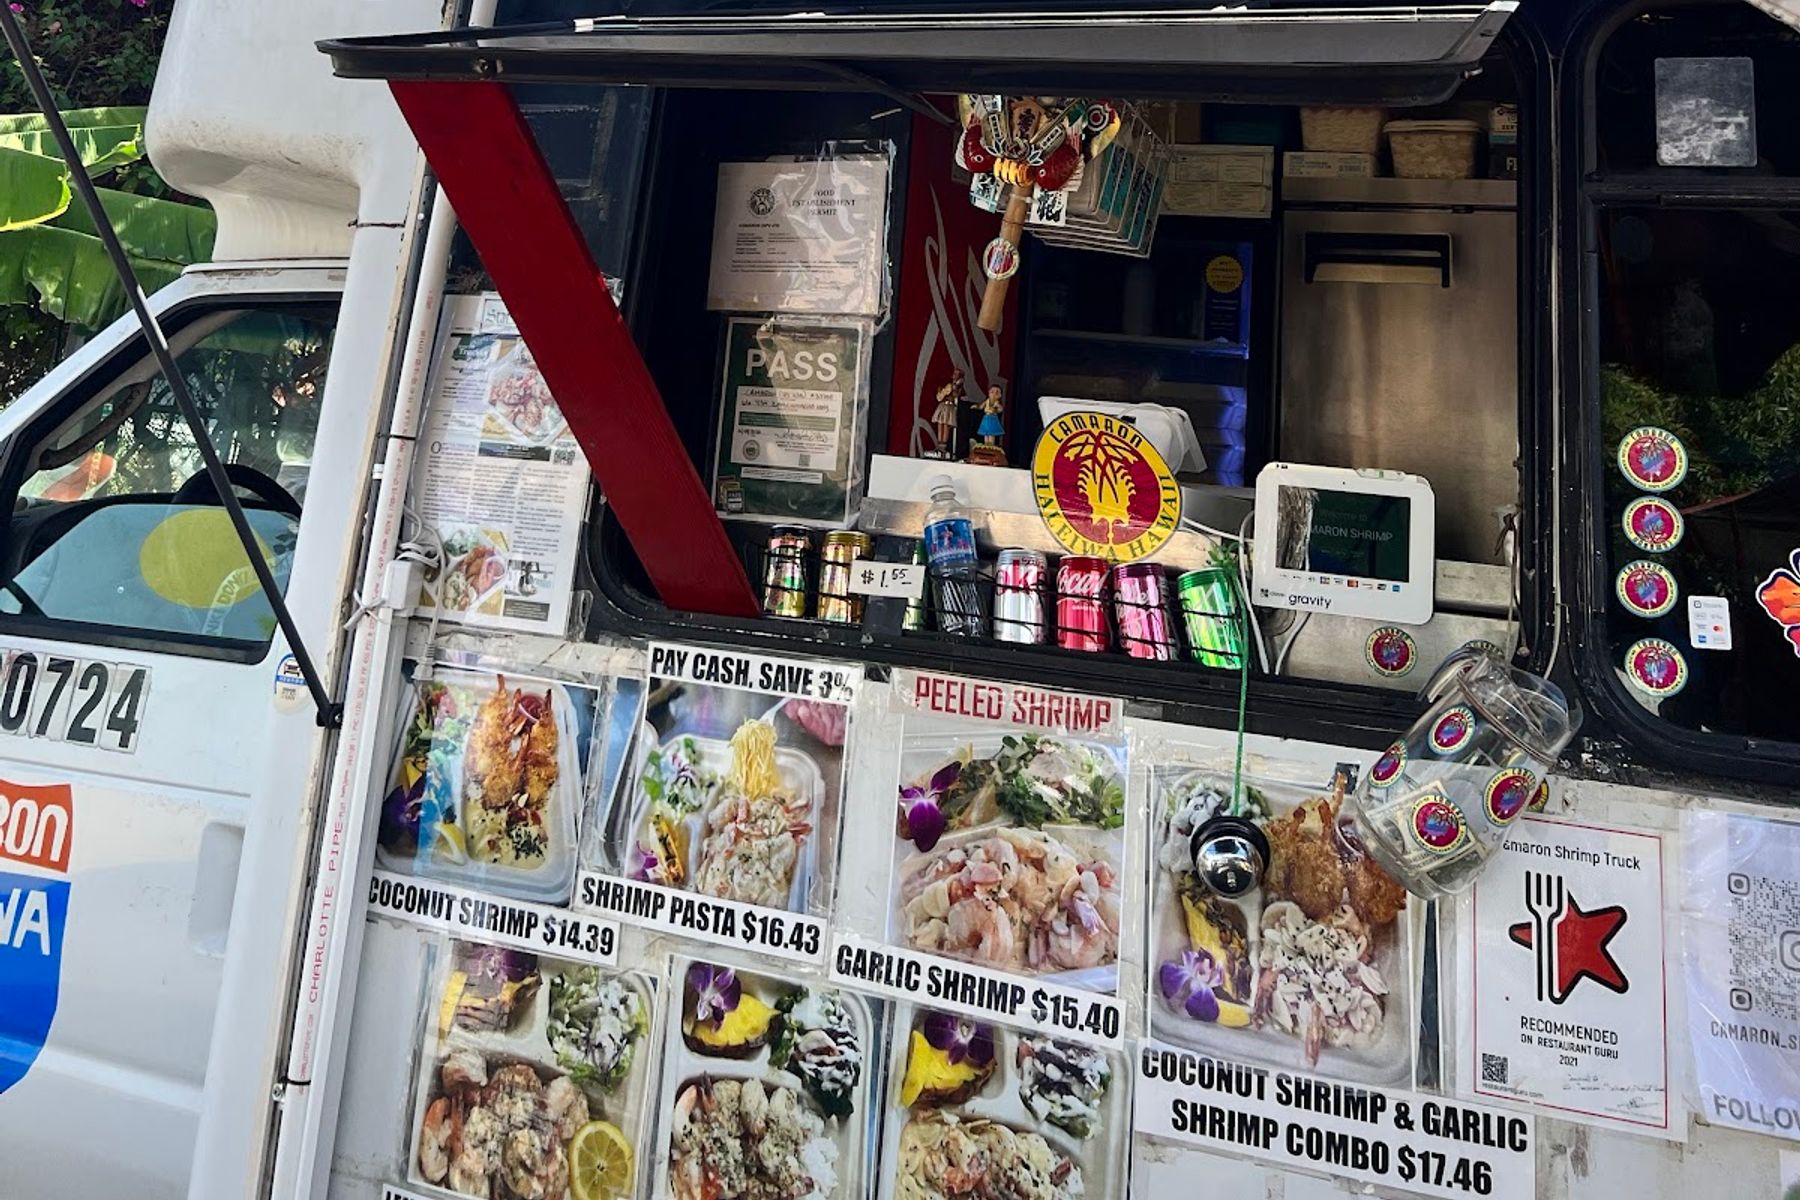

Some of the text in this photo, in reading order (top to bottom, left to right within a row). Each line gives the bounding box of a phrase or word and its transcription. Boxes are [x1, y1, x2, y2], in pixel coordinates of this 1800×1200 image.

[745, 348, 838, 383] PASS
[1050, 414, 1143, 449] CAMARON
[1128, 474, 1179, 559] HAWAII
[1310, 525, 1394, 542] MARON SHRIMP
[1289, 593, 1332, 609] gravity
[0, 652, 147, 748] 0724
[650, 647, 688, 677] PAY
[758, 662, 814, 696] SAVE
[818, 669, 854, 702] 3%
[914, 675, 1112, 732] PEELED SHRIMP
[1555, 845, 1601, 867] Shrimp
[1603, 851, 1642, 871] Truck
[309, 821, 345, 1003] CHARLOTTE PIPE
[368, 875, 615, 956] COCONUT SHRIMP $14.39
[581, 877, 821, 955] SHRIMP PASTA $16.43
[835, 943, 1119, 1039] GARLIC SHRIMP $15.40
[1520, 1015, 1619, 1046] RECOMMENDED
[1520, 1033, 1619, 1060] ON RESTAURANT GURU
[1710, 1020, 1800, 1050] CAMARON_S
[1558, 1054, 1579, 1067] 2021
[1141, 1046, 1528, 1153] COCONUT SHRIMP & GARLIC
[1171, 1098, 1493, 1196] SHRIMP COMBO $17.46
